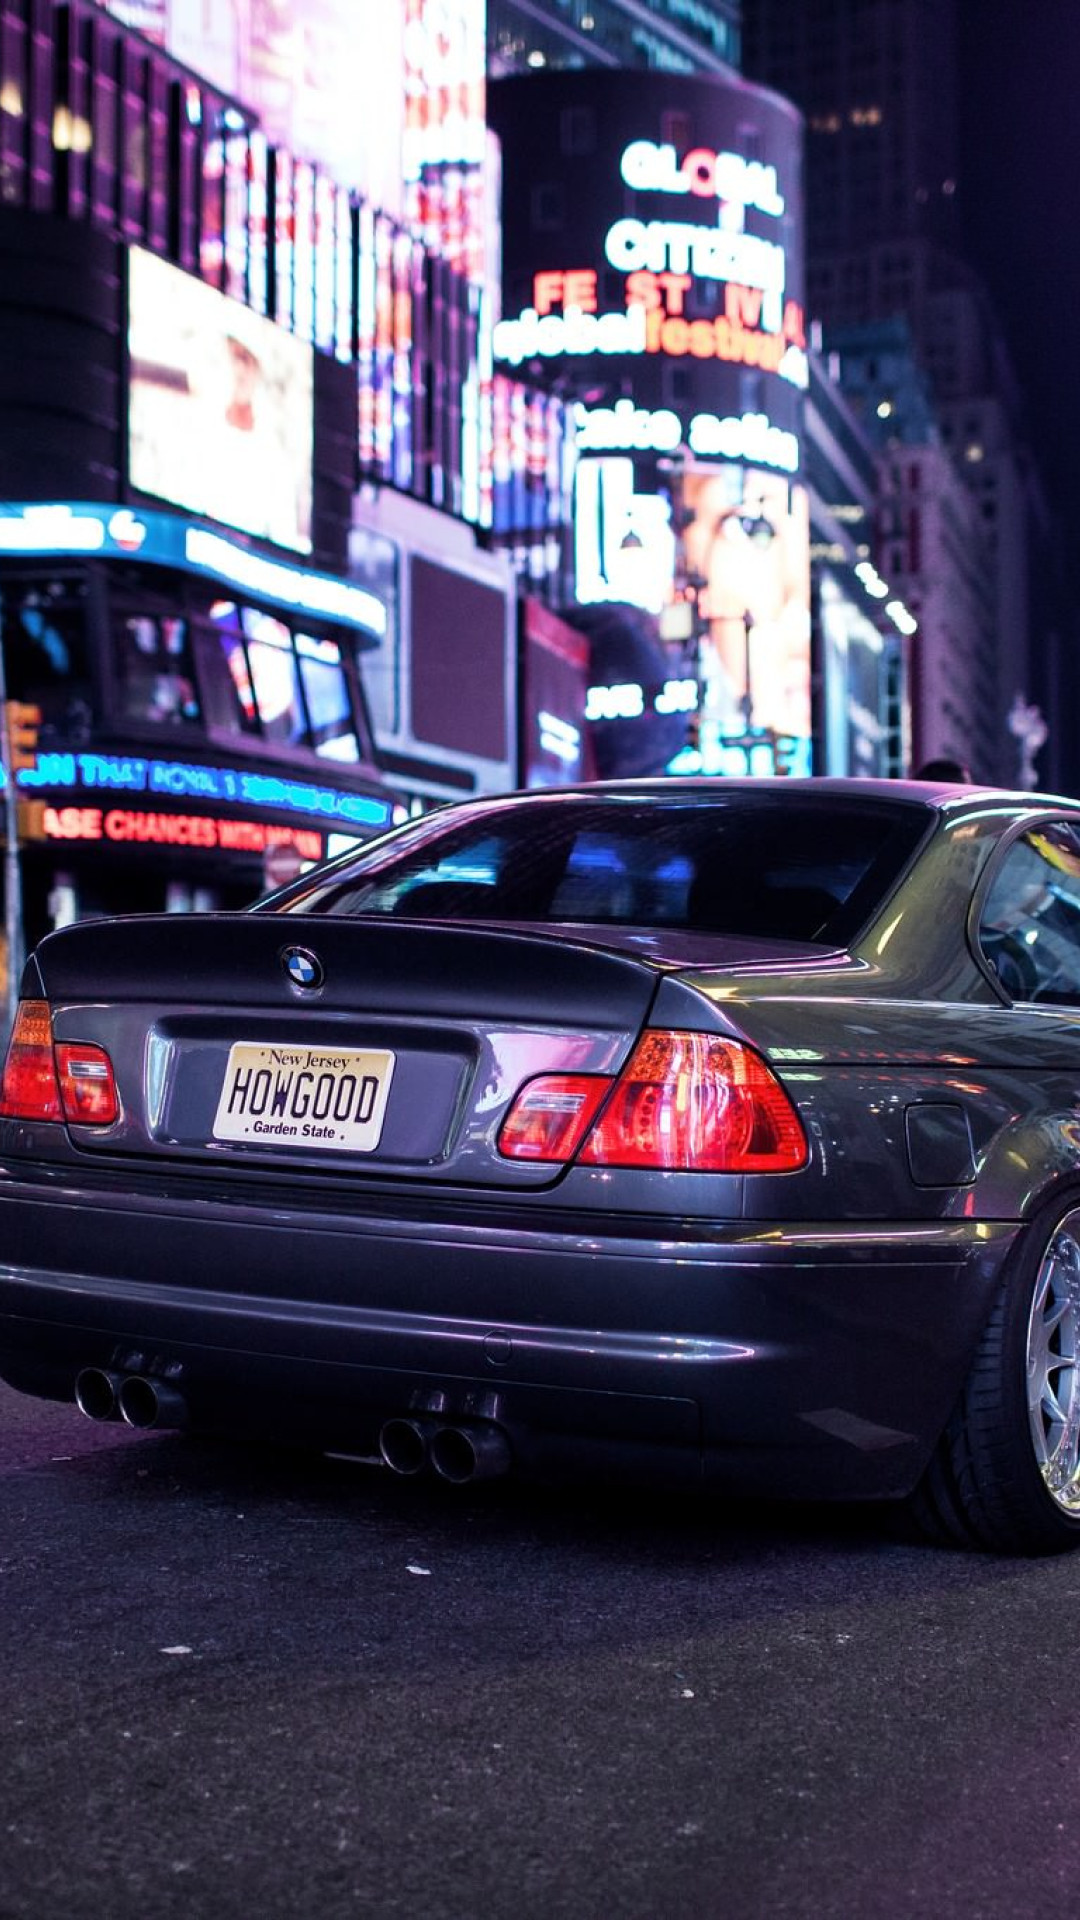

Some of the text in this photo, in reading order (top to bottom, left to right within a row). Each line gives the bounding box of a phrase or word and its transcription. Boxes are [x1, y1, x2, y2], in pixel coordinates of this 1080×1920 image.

[104, 809, 218, 848] CHANCES
[268, 1050, 350, 1072] New Jersey
[227, 1067, 380, 1124] HOWGOOD
[253, 1120, 336, 1139] Garden State
